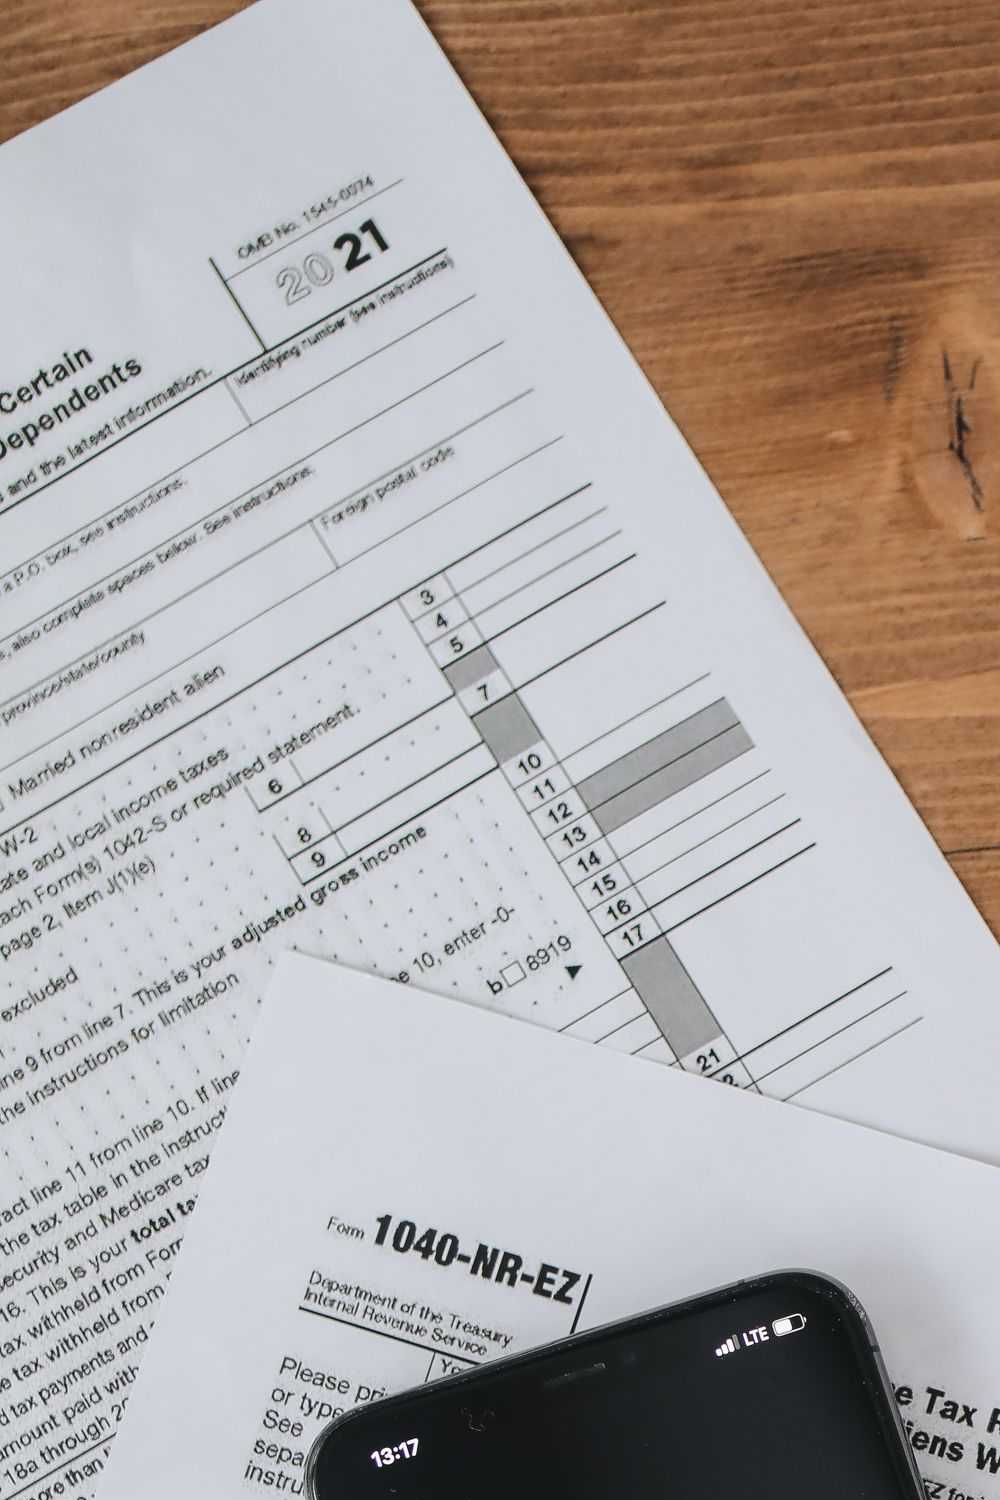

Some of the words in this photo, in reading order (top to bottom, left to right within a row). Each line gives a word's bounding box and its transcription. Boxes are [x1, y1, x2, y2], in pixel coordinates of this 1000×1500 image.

[0, 348, 94, 415] Certain
[6, 469, 38, 497] and
[39, 455, 67, 476] the
[66, 423, 115, 460] latest
[419, 589, 435, 606] 3
[436, 612, 449, 628] 4
[449, 635, 464, 654] 5
[476, 683, 489, 702] 7
[7, 749, 76, 800] Married
[79, 689, 182, 759] nonresident
[183, 665, 226, 696] alien
[518, 753, 542, 775] 10
[267, 778, 283, 795] 6
[533, 778, 556, 800] 11
[548, 801, 573, 824] 12
[33, 855, 102, 905] Form(s)
[103, 815, 168, 861] 1042-S
[170, 802, 188, 823] or
[192, 755, 266, 809] required
[297, 827, 312, 844] 8
[562, 826, 587, 848] 13
[310, 851, 326, 868] 9
[577, 850, 601, 873] 14
[591, 873, 617, 897] 15
[606, 899, 632, 921] 16
[443, 921, 487, 956] enter
[491, 906, 516, 925] -0-
[622, 923, 644, 947] 17
[24, 1055, 39, 1073] 9
[39, 1033, 83, 1065] from
[81, 1015, 114, 1040] line
[131, 980, 172, 1007] This
[170, 969, 189, 985] is
[190, 945, 227, 979] your
[231, 894, 307, 951] adjusted
[309, 867, 360, 907] gross
[359, 826, 427, 873] income
[525, 935, 572, 971] 8919
[25, 1039, 129, 1106] instructions
[130, 1020, 156, 1044] for
[157, 973, 240, 1027] limitation
[29, 1179, 63, 1205] line
[65, 1160, 87, 1183] 11
[89, 1137, 133, 1169] from
[131, 1118, 164, 1143] line
[195, 1085, 210, 1105] If
[326, 1215, 365, 1240] Form
[374, 1214, 582, 1306] 1040-NR-EZ
[303, 1286, 360, 1317] Internal
[362, 1304, 428, 1338] Revenue
[431, 1327, 488, 1357] Service
[308, 1270, 398, 1310] Department
[400, 1303, 417, 1316] of
[419, 1305, 444, 1324] the
[449, 1313, 514, 1350] Treasury
[742, 1326, 770, 1347] LTE
[279, 1356, 351, 1395] Please
[925, 1385, 978, 1429] Tax
[262, 1409, 304, 1438] See
[370, 1437, 419, 1468] 13:17
